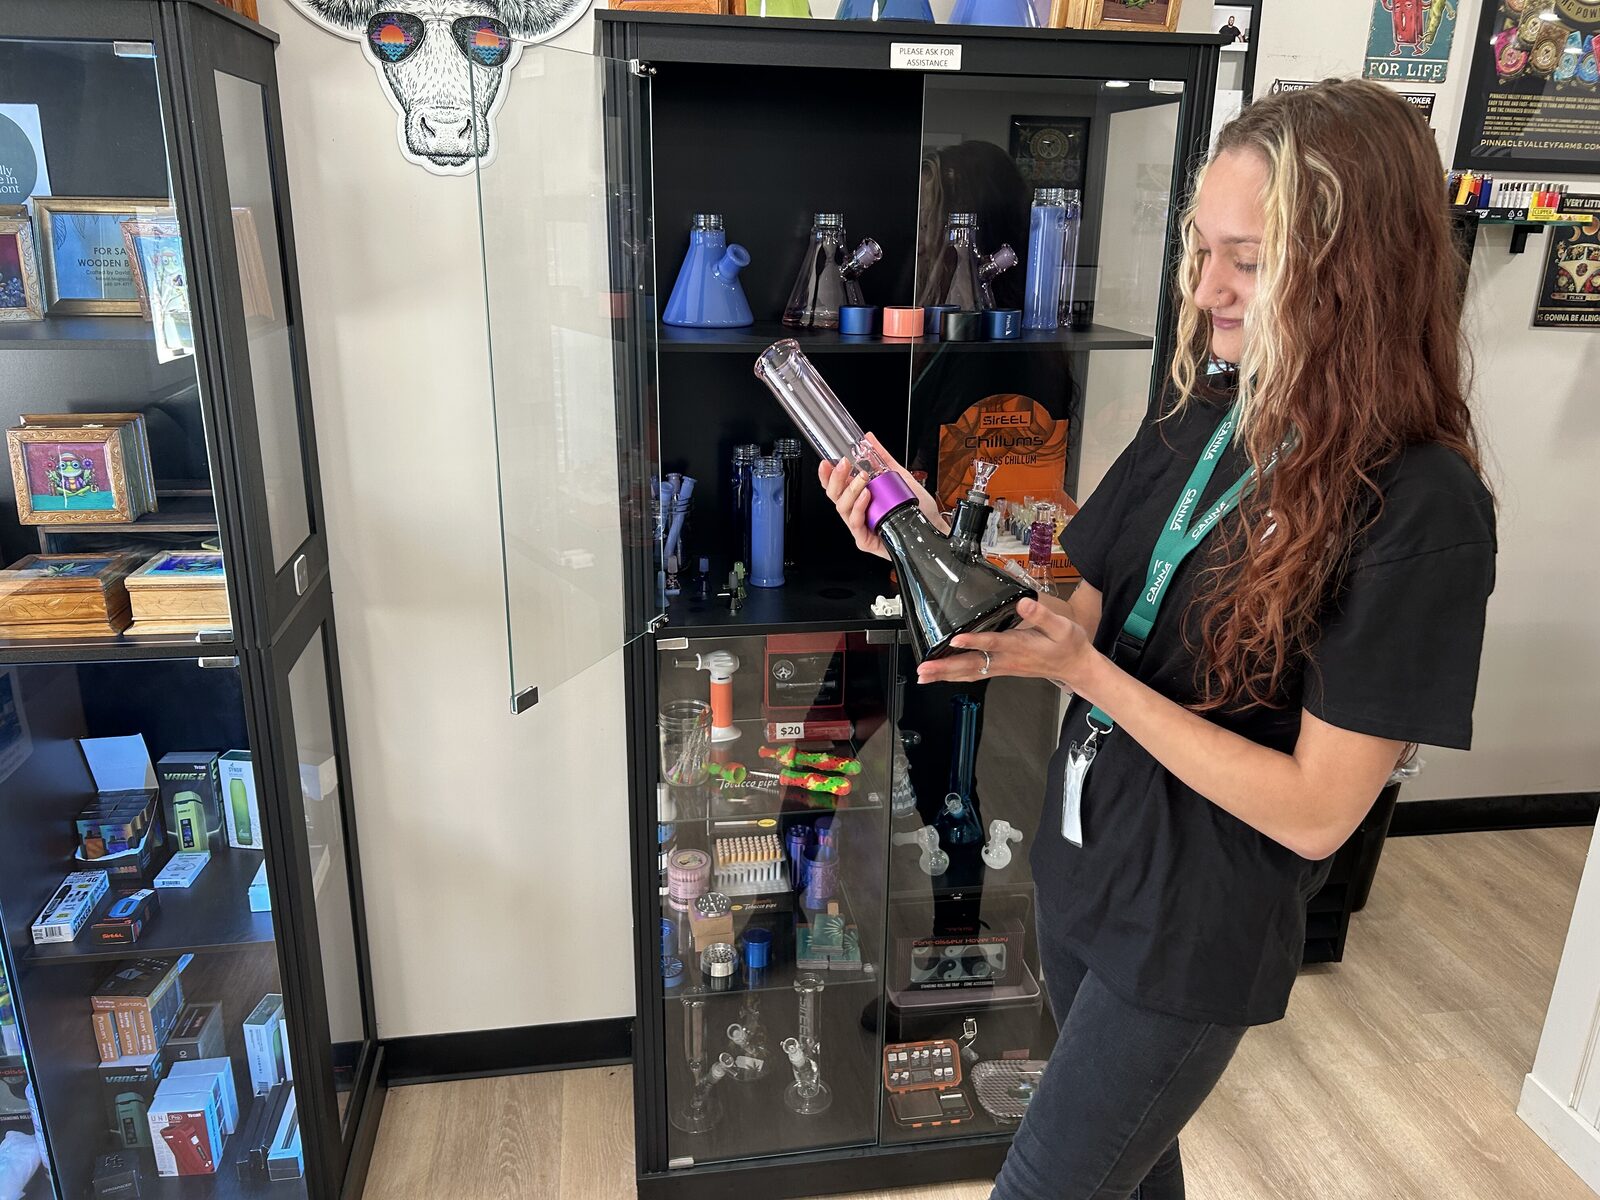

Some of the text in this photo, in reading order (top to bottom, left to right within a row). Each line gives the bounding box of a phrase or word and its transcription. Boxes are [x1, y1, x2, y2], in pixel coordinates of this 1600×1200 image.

[1575, 7, 1600, 18] POW
[899, 47, 955, 56] PLEASE ASK FOR
[906, 59, 948, 67] ASSISTANCE
[1368, 62, 1443, 77] FOR LIFE
[1407, 96, 1431, 104] POKER
[93, 247, 112, 255] FOR
[77, 258, 122, 267] WOODEN
[1544, 313, 1569, 322] GONNA
[1570, 314, 1580, 322] BE
[982, 415, 1028, 426] SirEEL
[964, 435, 1044, 449] Chillums
[1204, 421, 1232, 460] CANNA
[1004, 454, 1037, 465] CHILLUM
[1170, 488, 1197, 531] CANNA
[1191, 501, 1229, 540] CANNA
[1146, 562, 1172, 604] CANNA
[780, 725, 801, 736] $20
[757, 779, 779, 789] pipe
[742, 903, 765, 911] Tobacco
